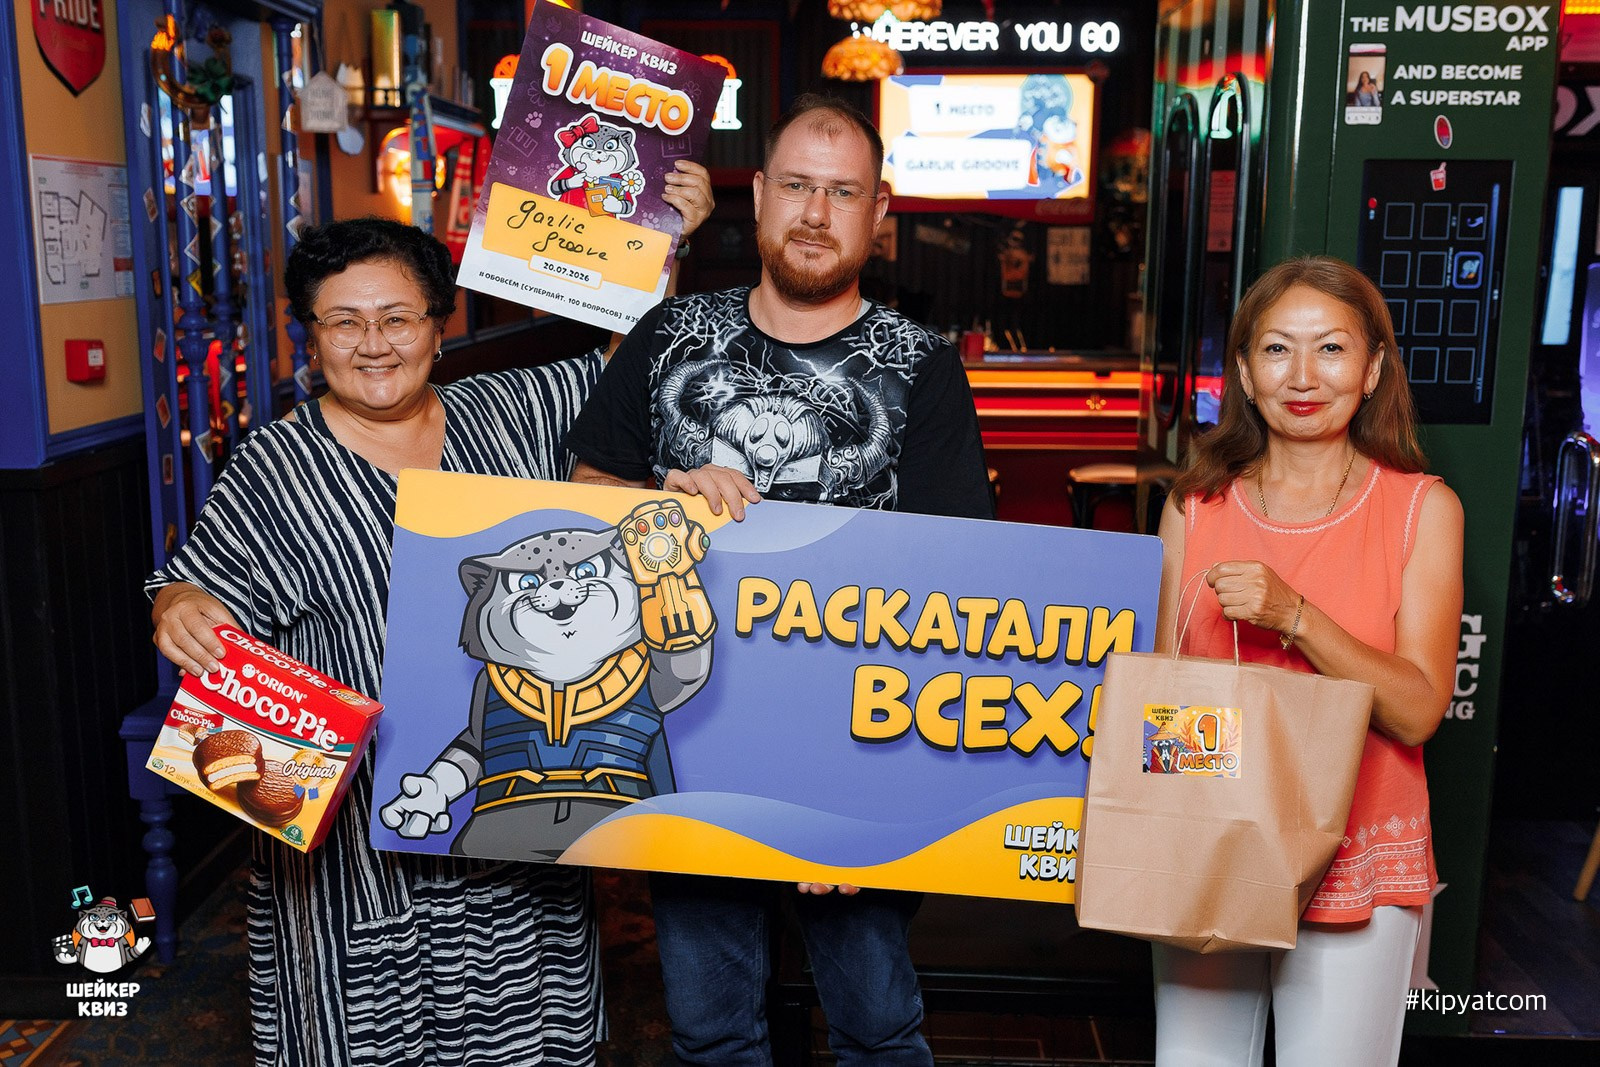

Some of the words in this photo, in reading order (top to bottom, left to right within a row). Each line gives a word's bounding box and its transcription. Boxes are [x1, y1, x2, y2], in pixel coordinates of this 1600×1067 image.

[1350, 17, 1390, 33] THE
[1394, 5, 1550, 33] MUSBOX
[1014, 21, 1072, 53] YOU
[1080, 21, 1121, 53] GO
[1505, 36, 1549, 51] APP
[580, 30, 638, 60] ШЕЙКЕР
[640, 52, 678, 75] КВИЗ
[1393, 65, 1437, 80] AND
[1441, 65, 1523, 80] BECOME
[542, 44, 572, 94] 1
[568, 62, 692, 133] МЕСТО
[1390, 90, 1406, 105] A
[1410, 90, 1521, 106] SUPERSTAR
[543, 262, 590, 282] 20.07.2026
[568, 298, 581, 306] 100
[582, 301, 622, 319] ВОПРОСОВ]
[736, 577, 1136, 667] РАСКАТАЛИ
[328, 688, 371, 706] Original
[1151, 707, 1178, 715] ШЕЙКЕР
[1197, 714, 1217, 751] 1
[165, 764, 176, 777] 12
[283, 760, 336, 779] Original
[1178, 753, 1238, 770] МЕСТО
[1020, 854, 1077, 883] КВИ
